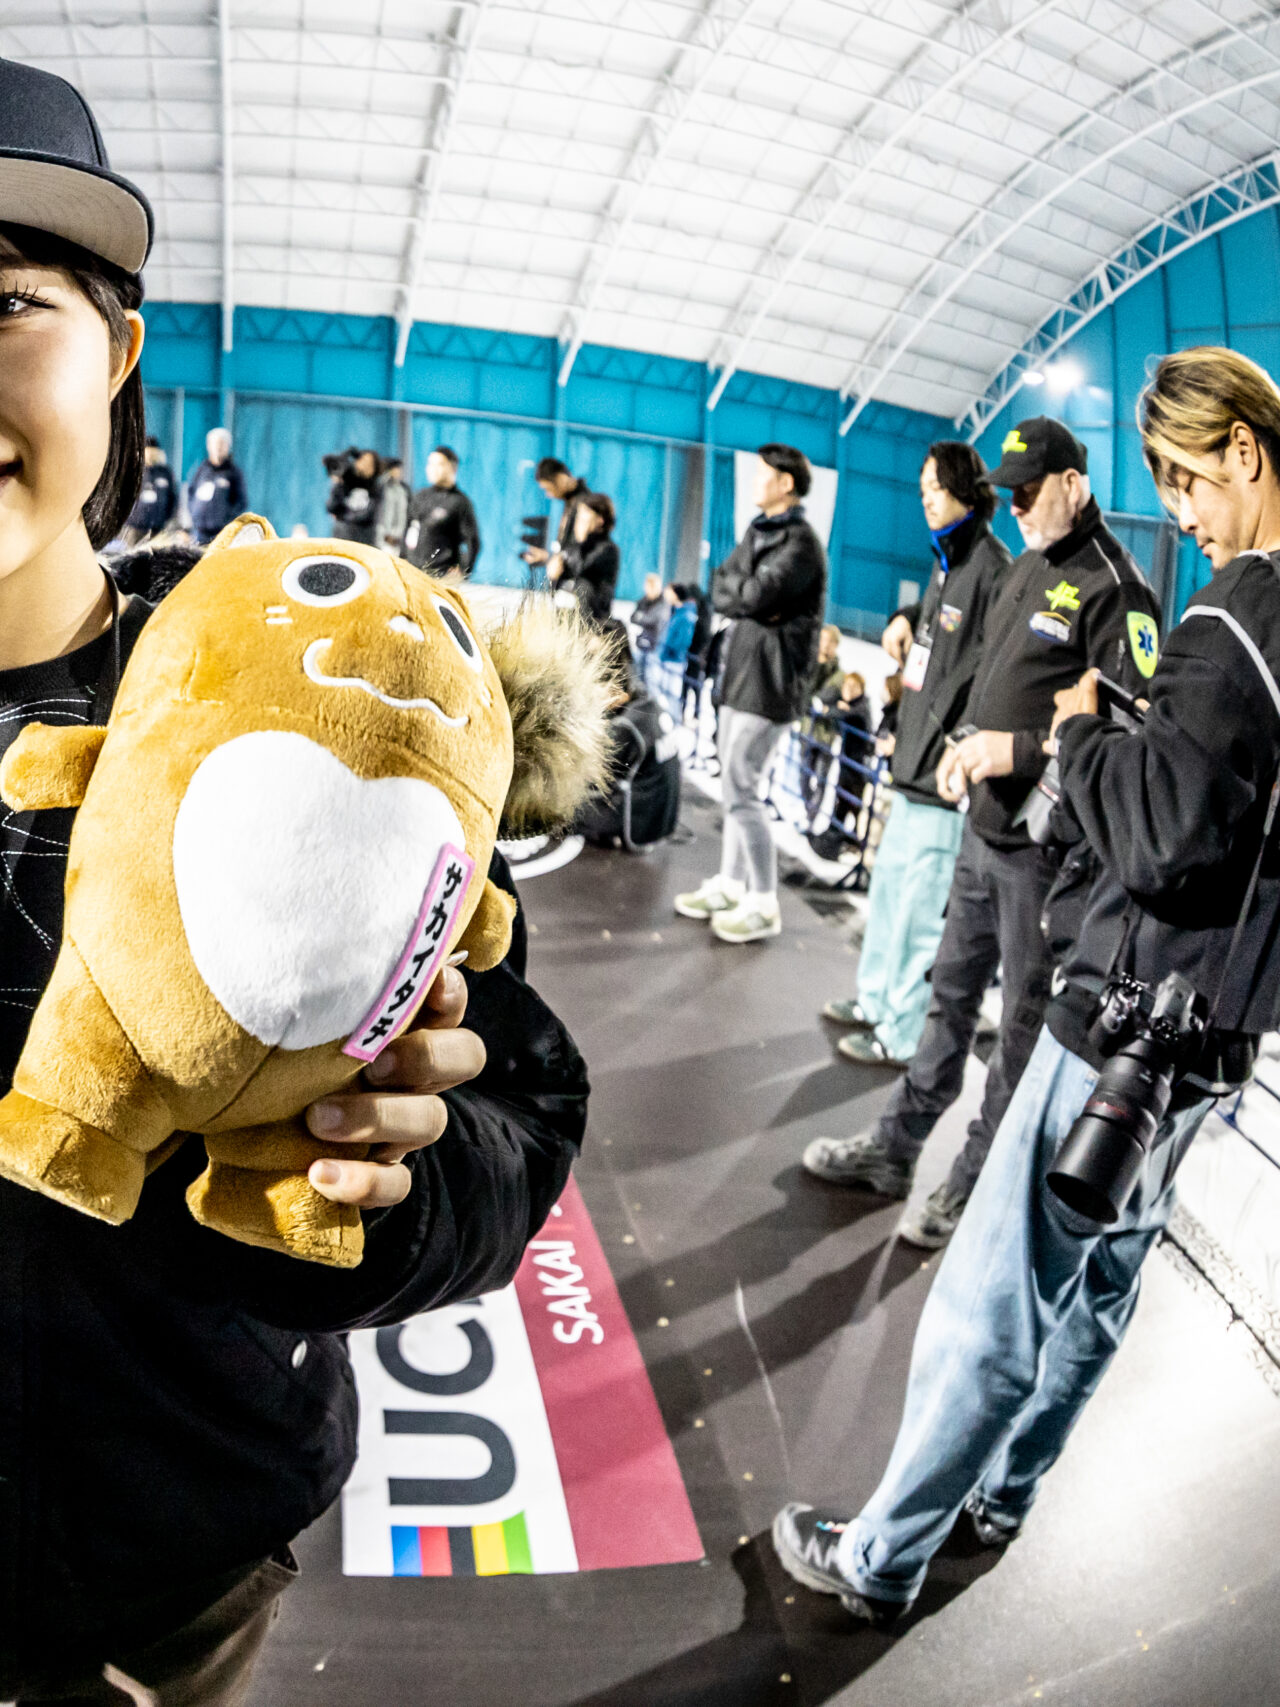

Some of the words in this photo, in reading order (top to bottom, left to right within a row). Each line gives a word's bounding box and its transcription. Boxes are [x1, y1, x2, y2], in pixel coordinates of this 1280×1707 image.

[361, 862, 463, 1047] サカイタチ
[528, 1240, 605, 1345] SAKAI
[375, 1298, 517, 1506] UC
